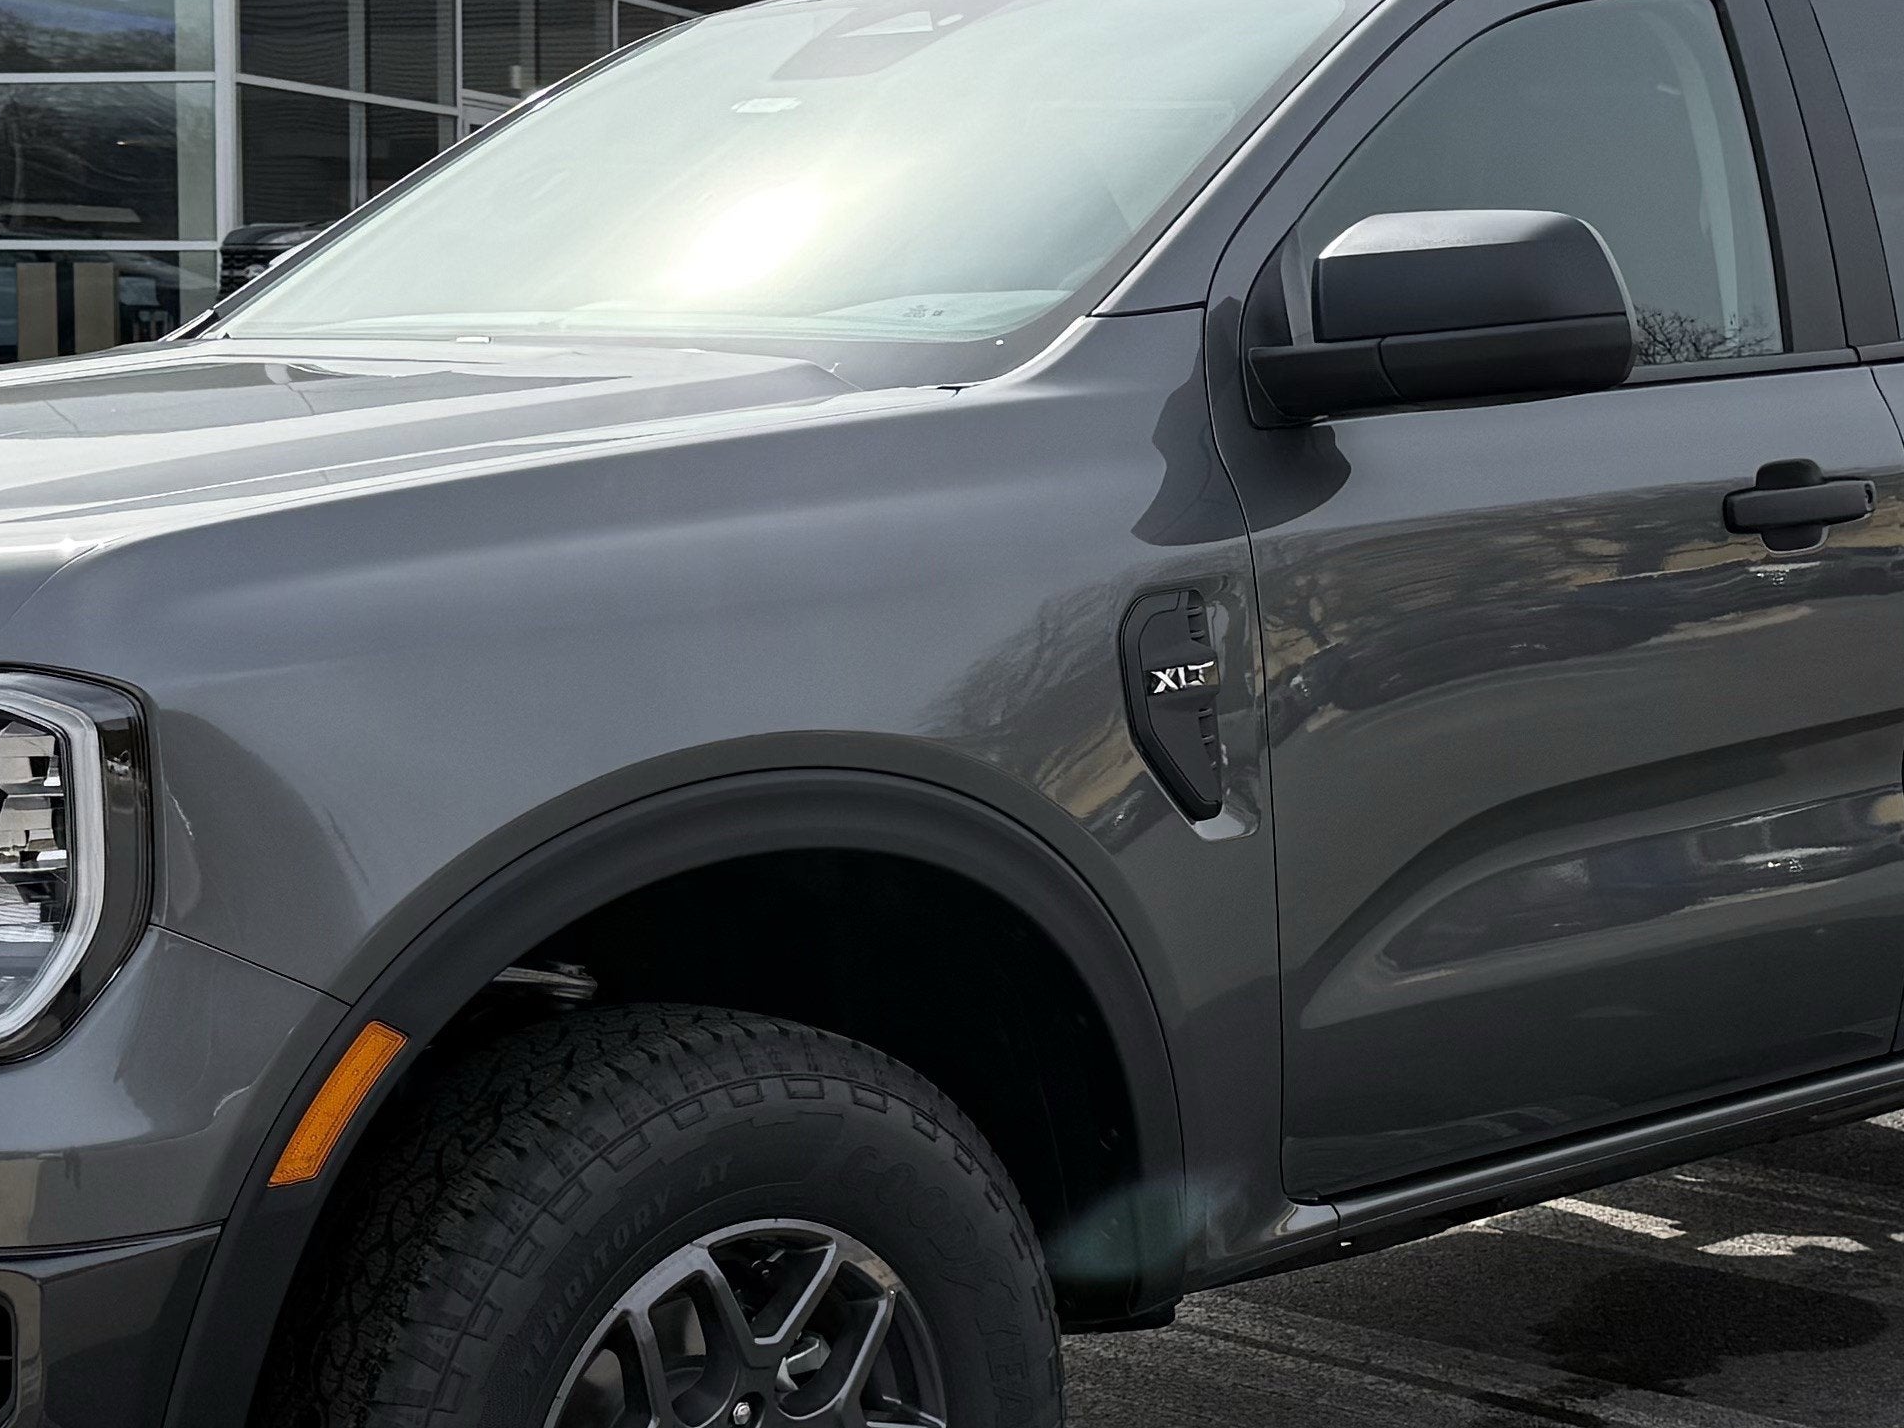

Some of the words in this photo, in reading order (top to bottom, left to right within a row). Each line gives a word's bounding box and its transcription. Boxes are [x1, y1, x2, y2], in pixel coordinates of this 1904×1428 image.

[1150, 659, 1216, 694] XLT
[522, 1188, 673, 1376] TERRITORY
[696, 1153, 736, 1194] AT
